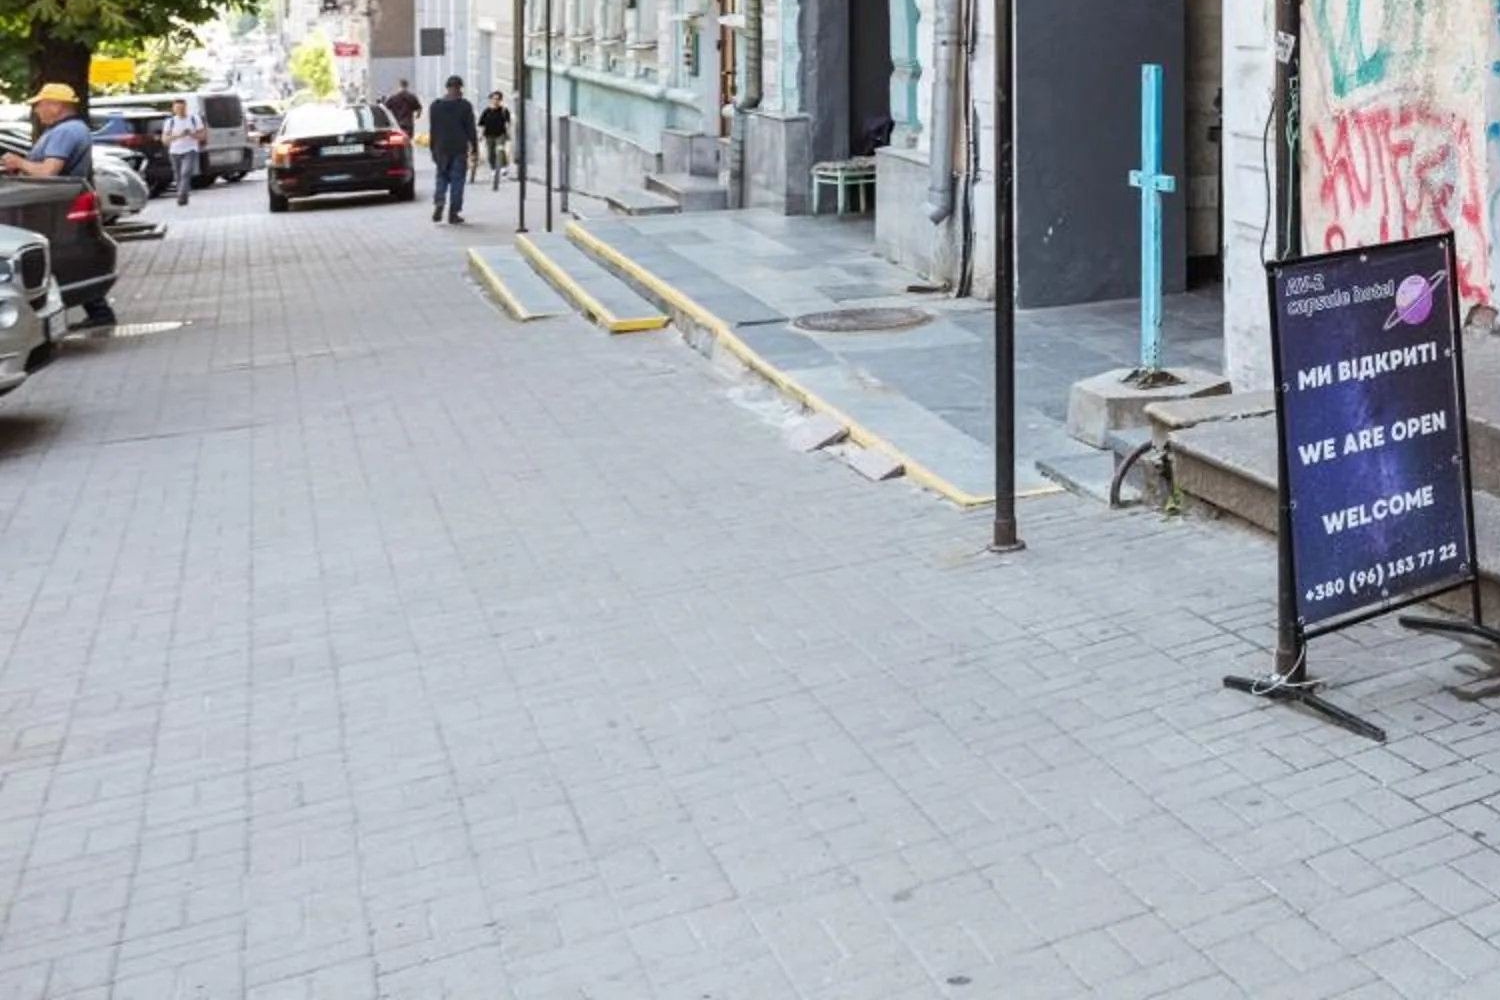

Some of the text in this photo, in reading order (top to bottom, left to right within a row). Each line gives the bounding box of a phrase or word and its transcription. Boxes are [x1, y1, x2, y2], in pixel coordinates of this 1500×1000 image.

[1287, 279, 1395, 317] capsule hotel
[1297, 341, 1437, 390] МИ ВІДКРИТІ
[1298, 410, 1447, 466] WE ARE OPEN
[1321, 485, 1435, 535] WELCOME
[1305, 543, 1457, 602] +380 (96) 183 77 22
